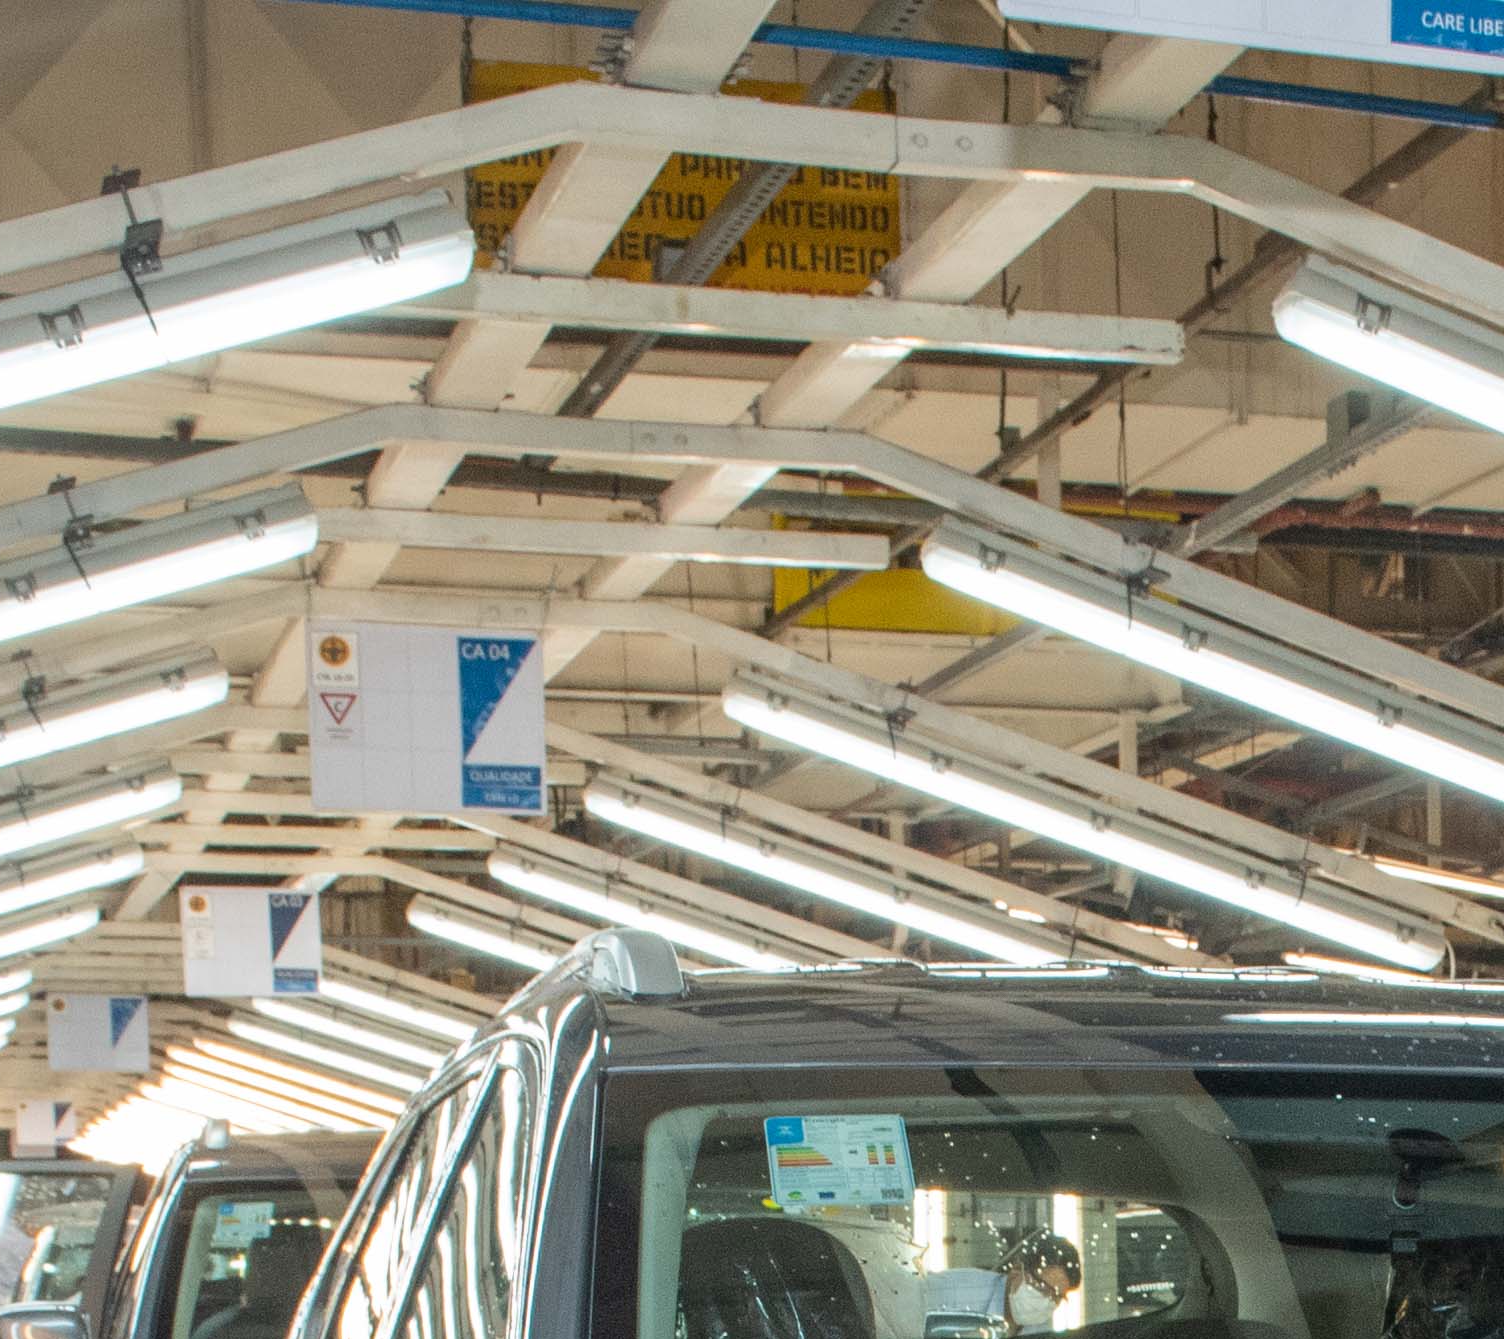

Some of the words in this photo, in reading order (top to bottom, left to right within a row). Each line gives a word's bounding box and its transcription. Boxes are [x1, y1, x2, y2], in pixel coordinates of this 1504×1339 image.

[1421, 11, 1465, 33] CARE
[461, 644, 485, 660] CA
[488, 645, 510, 661] 04
